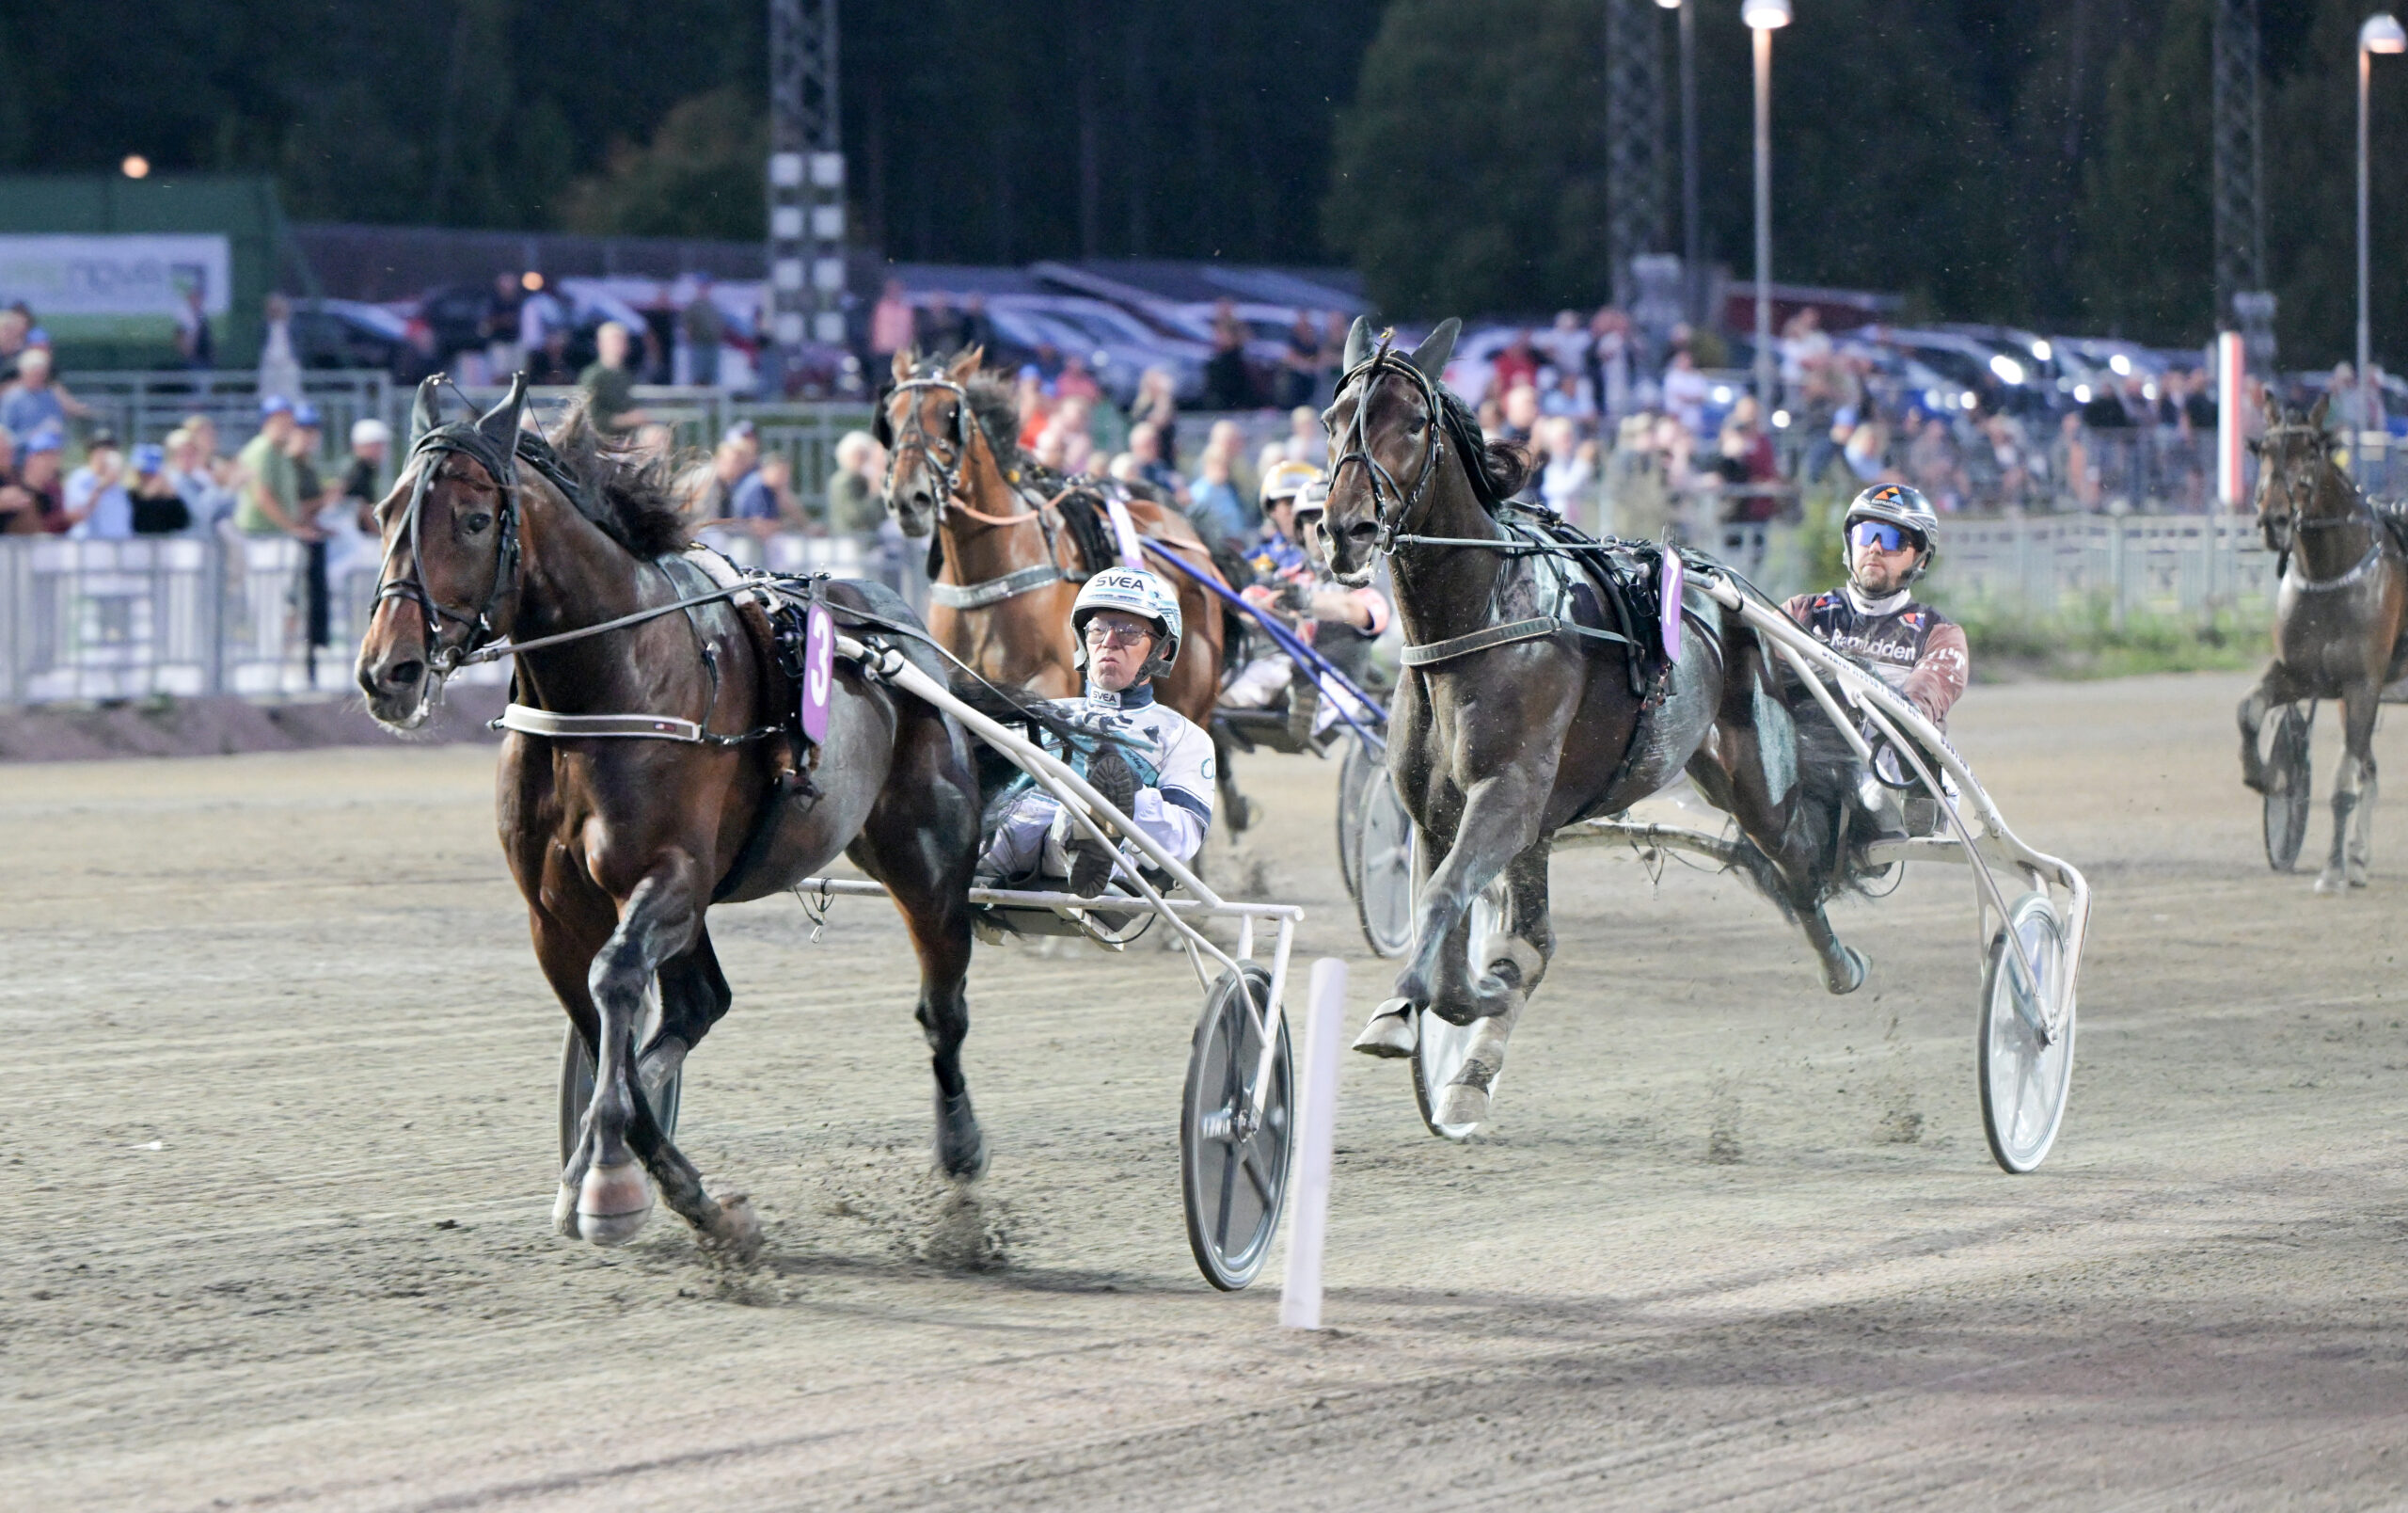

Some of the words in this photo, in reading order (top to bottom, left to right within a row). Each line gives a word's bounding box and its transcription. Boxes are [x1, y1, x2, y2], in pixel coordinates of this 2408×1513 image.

[1095, 576, 1144, 592] SVEA
[1666, 548, 1680, 627] 7
[811, 612, 830, 707] 3
[1093, 690, 1117, 703] SVEA
